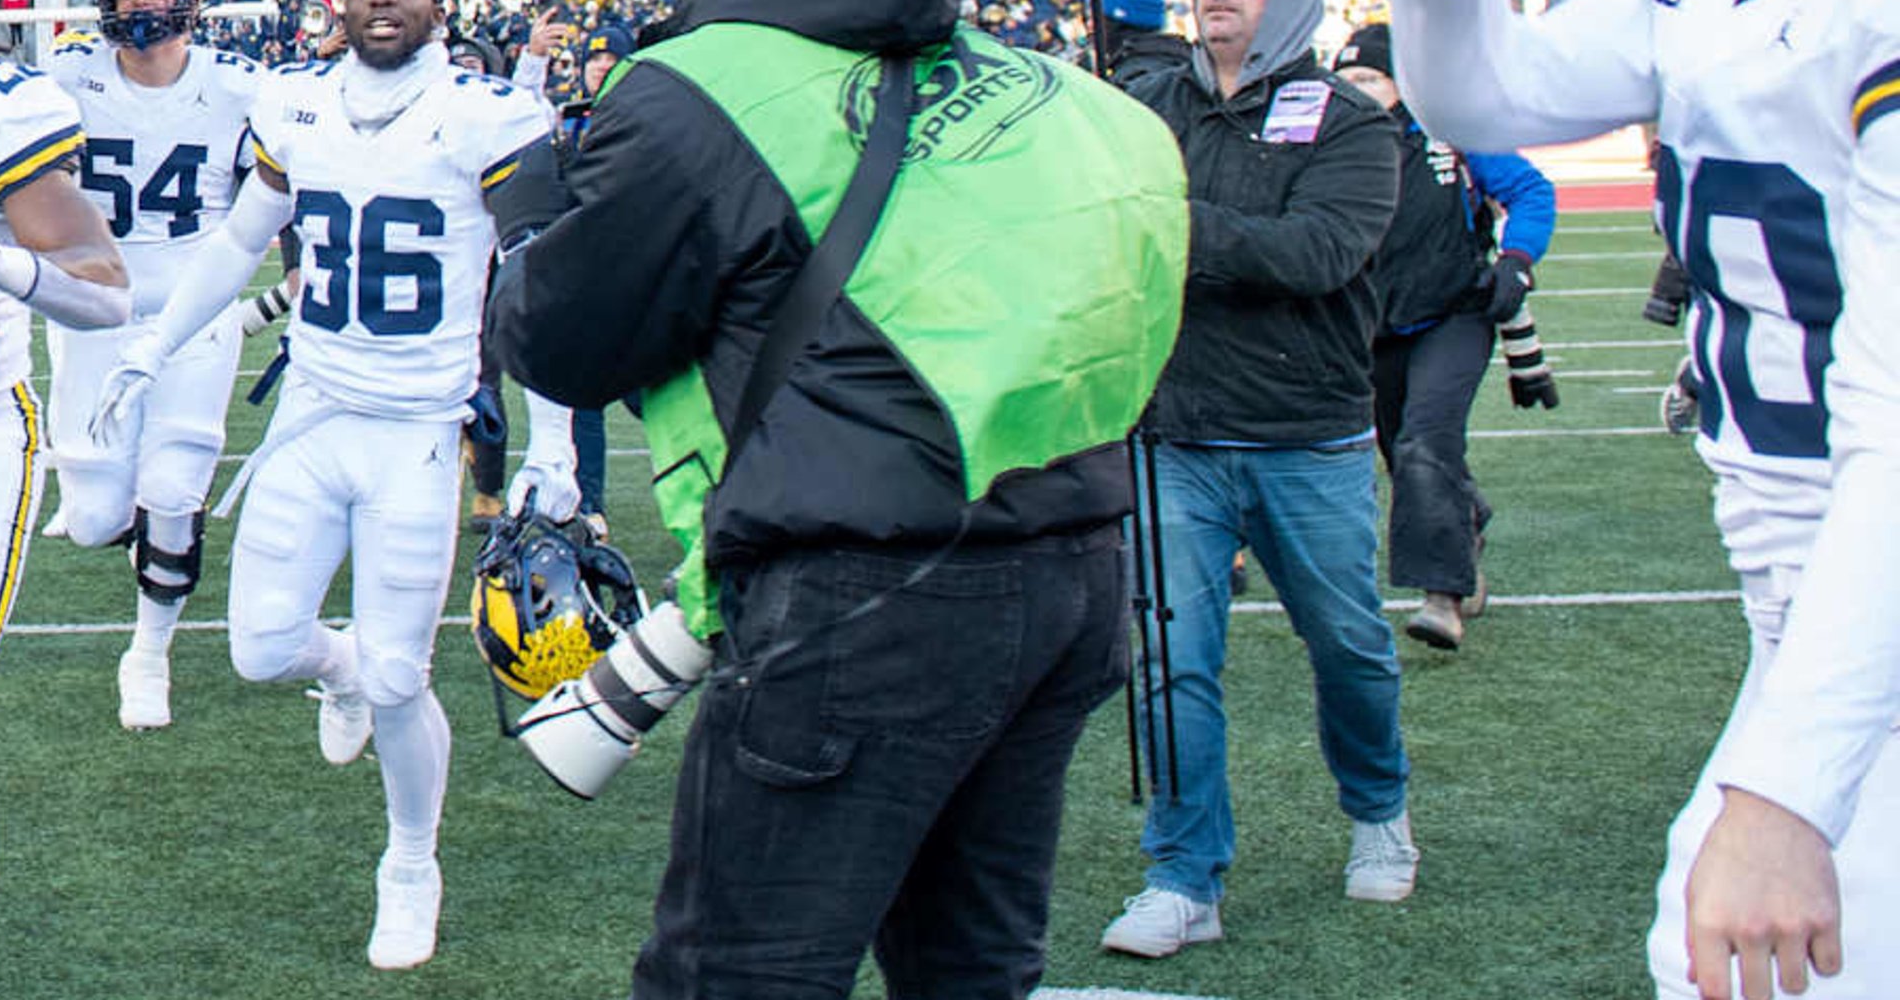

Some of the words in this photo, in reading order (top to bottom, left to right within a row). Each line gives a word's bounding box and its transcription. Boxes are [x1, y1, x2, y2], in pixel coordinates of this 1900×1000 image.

[901, 67, 1034, 162] SPORTS
[80, 138, 208, 239] 54
[298, 187, 445, 337] 36
